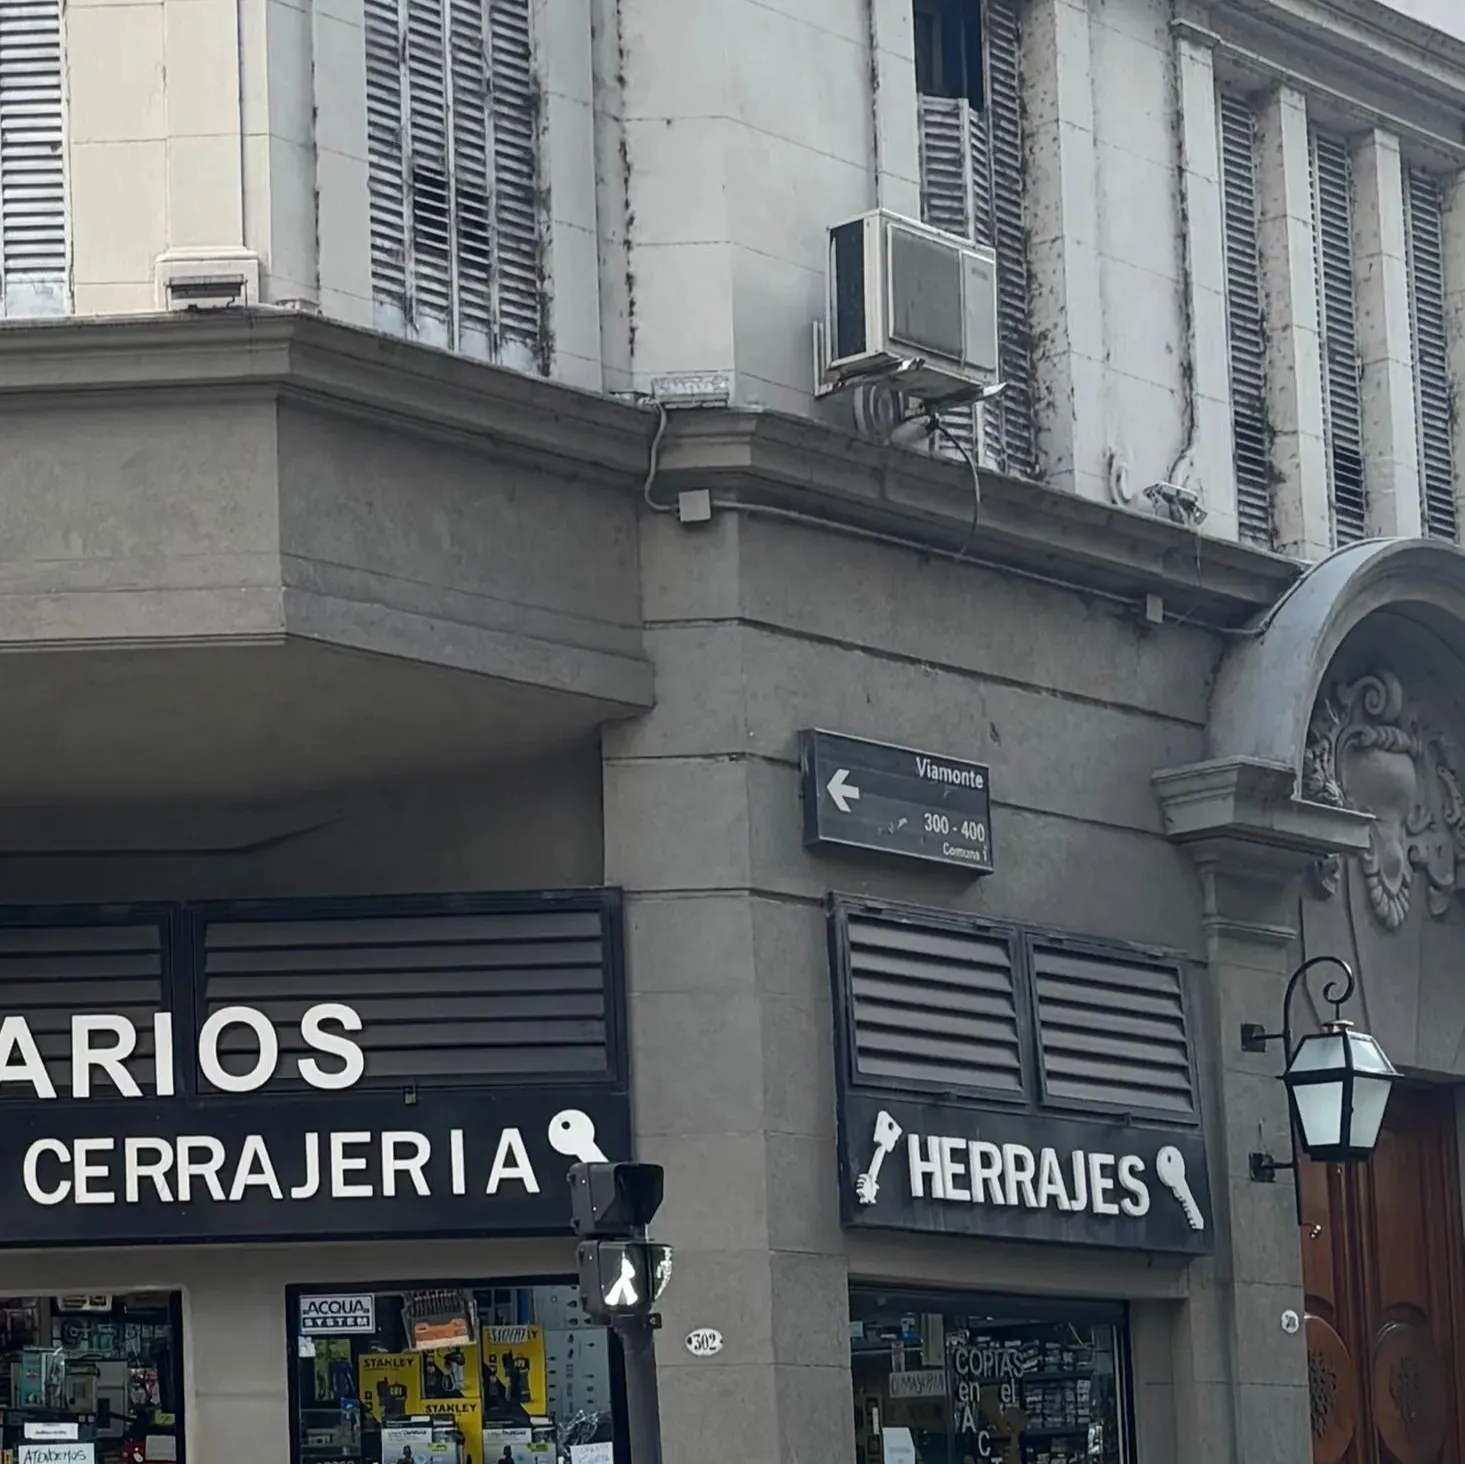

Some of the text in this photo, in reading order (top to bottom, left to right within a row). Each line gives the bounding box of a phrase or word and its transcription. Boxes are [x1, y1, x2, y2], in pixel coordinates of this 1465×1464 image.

[915, 755, 985, 790] Viamonte
[923, 812, 949, 835] 300
[961, 820, 986, 842] 400
[941, 842, 980, 863] Comuna
[23, 1128, 541, 1205] CERRAJERIA
[908, 1133, 1151, 1217] HERRAJES
[307, 1299, 365, 1315] ACQUA
[303, 1317, 368, 1328] SYSTEM
[692, 1332, 717, 1351] 302
[363, 1357, 415, 1368] STANLEY
[955, 1348, 1024, 1378] COPIAS
[958, 1380, 980, 1402] en
[1000, 1377, 1015, 1404] el
[424, 1402, 477, 1414] STANLEY
